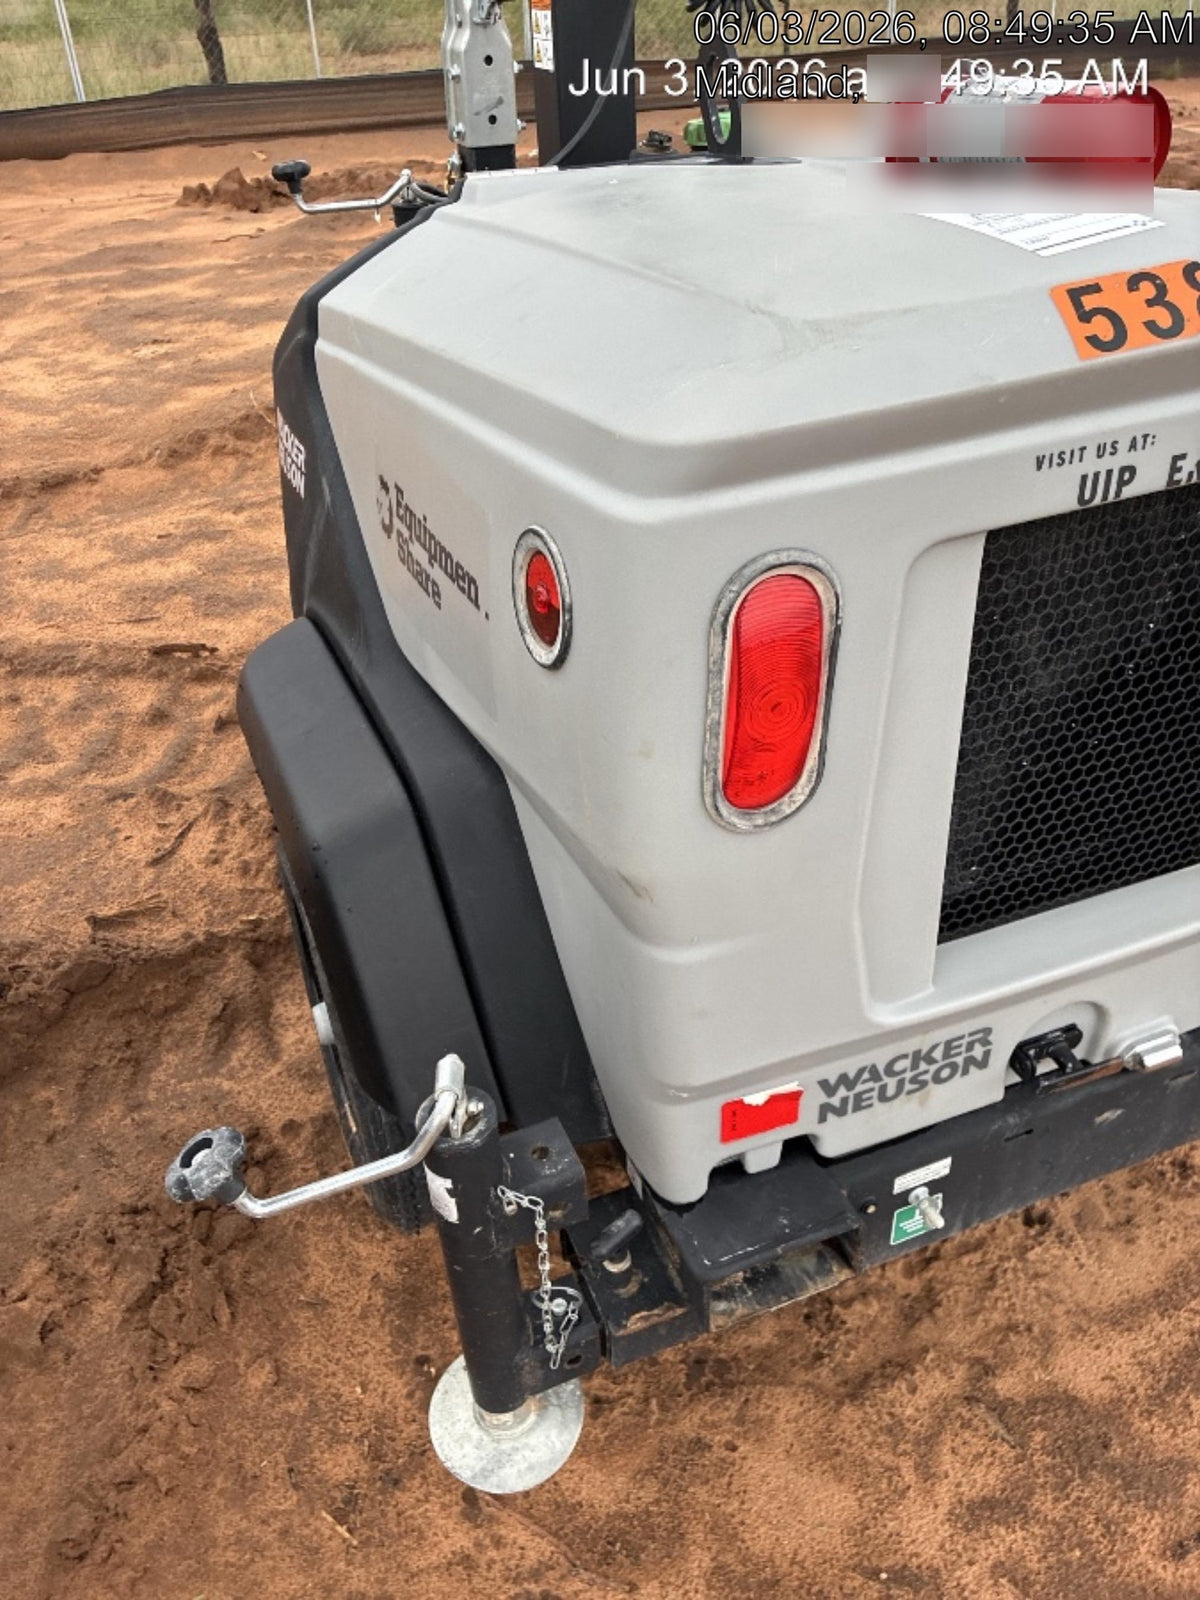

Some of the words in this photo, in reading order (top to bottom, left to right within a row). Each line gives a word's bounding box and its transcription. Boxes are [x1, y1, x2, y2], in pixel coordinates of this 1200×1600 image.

[1036, 446, 1087, 472] VISIT
[1096, 440, 1119, 459] US
[1128, 433, 1156, 452] AT:
[394, 481, 489, 621] Equipmen
[396, 528, 442, 611] Share
[817, 1026, 993, 1099] WACKER
[817, 1049, 992, 1124] NEUSON
